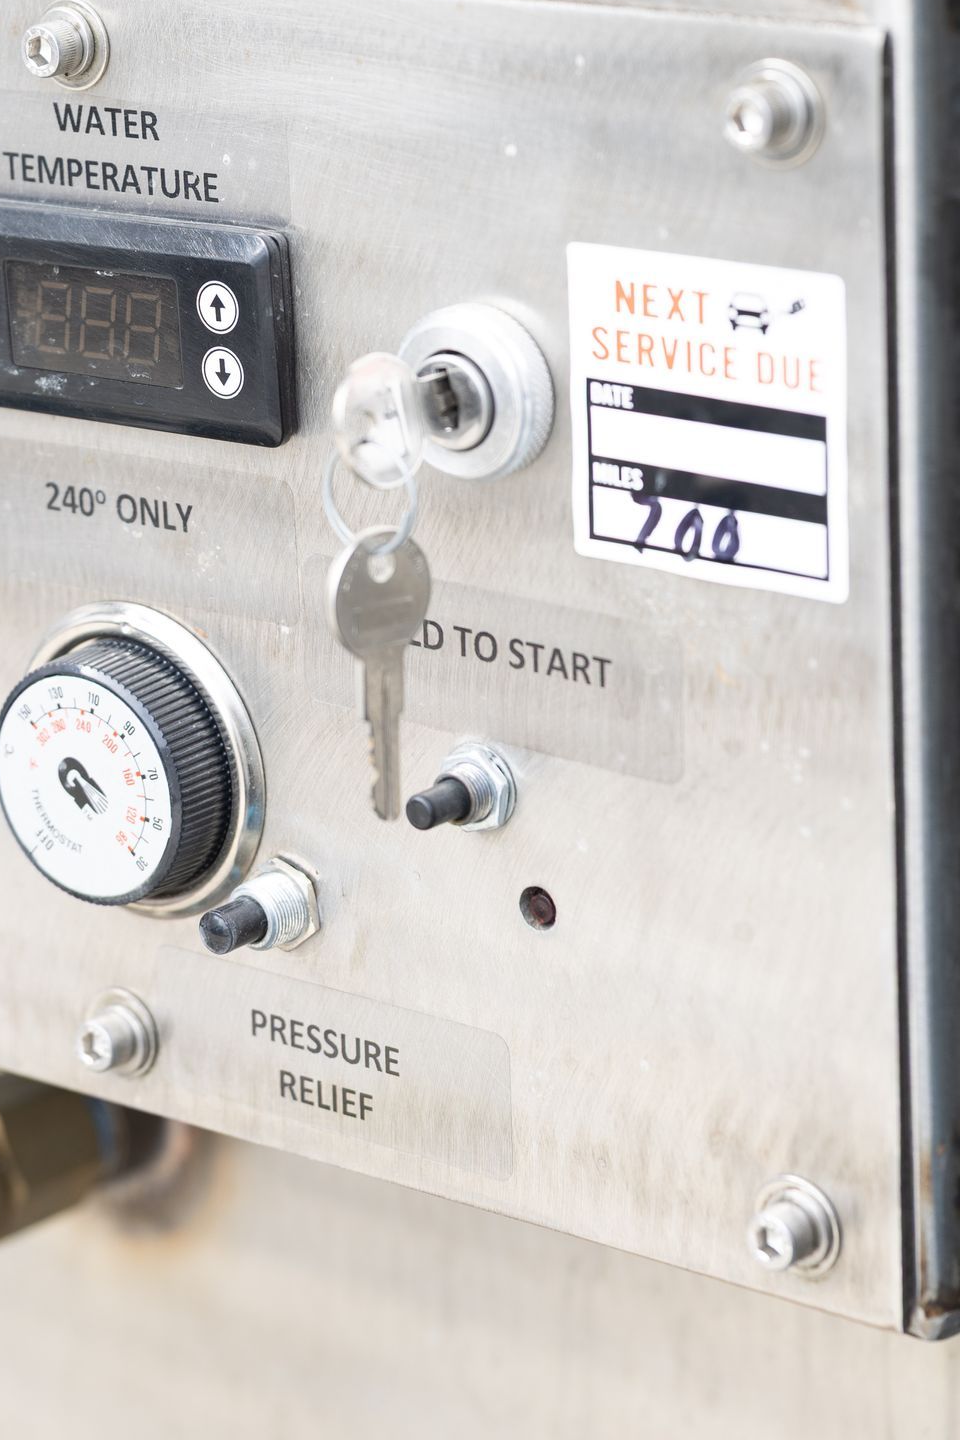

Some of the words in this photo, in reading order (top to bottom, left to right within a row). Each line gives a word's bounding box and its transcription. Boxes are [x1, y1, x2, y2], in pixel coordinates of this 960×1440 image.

[53, 102, 160, 141] WATER
[2, 151, 219, 203] TEMPERATURE
[615, 280, 710, 325] NEXT
[591, 326, 738, 381] SERVICE
[757, 351, 825, 393] DUE
[590, 381, 635, 410] DATE
[116, 493, 193, 533] ONLY
[452, 625, 498, 663] TO
[508, 638, 613, 688] START
[88, 691, 100, 706] 110
[102, 734, 118, 754] 200
[123, 720, 136, 736] 90
[147, 767, 159, 781] 70
[152, 816, 164, 831] 50
[251, 1008, 400, 1077] PRESSURE
[279, 1069, 374, 1121] RELIEF
